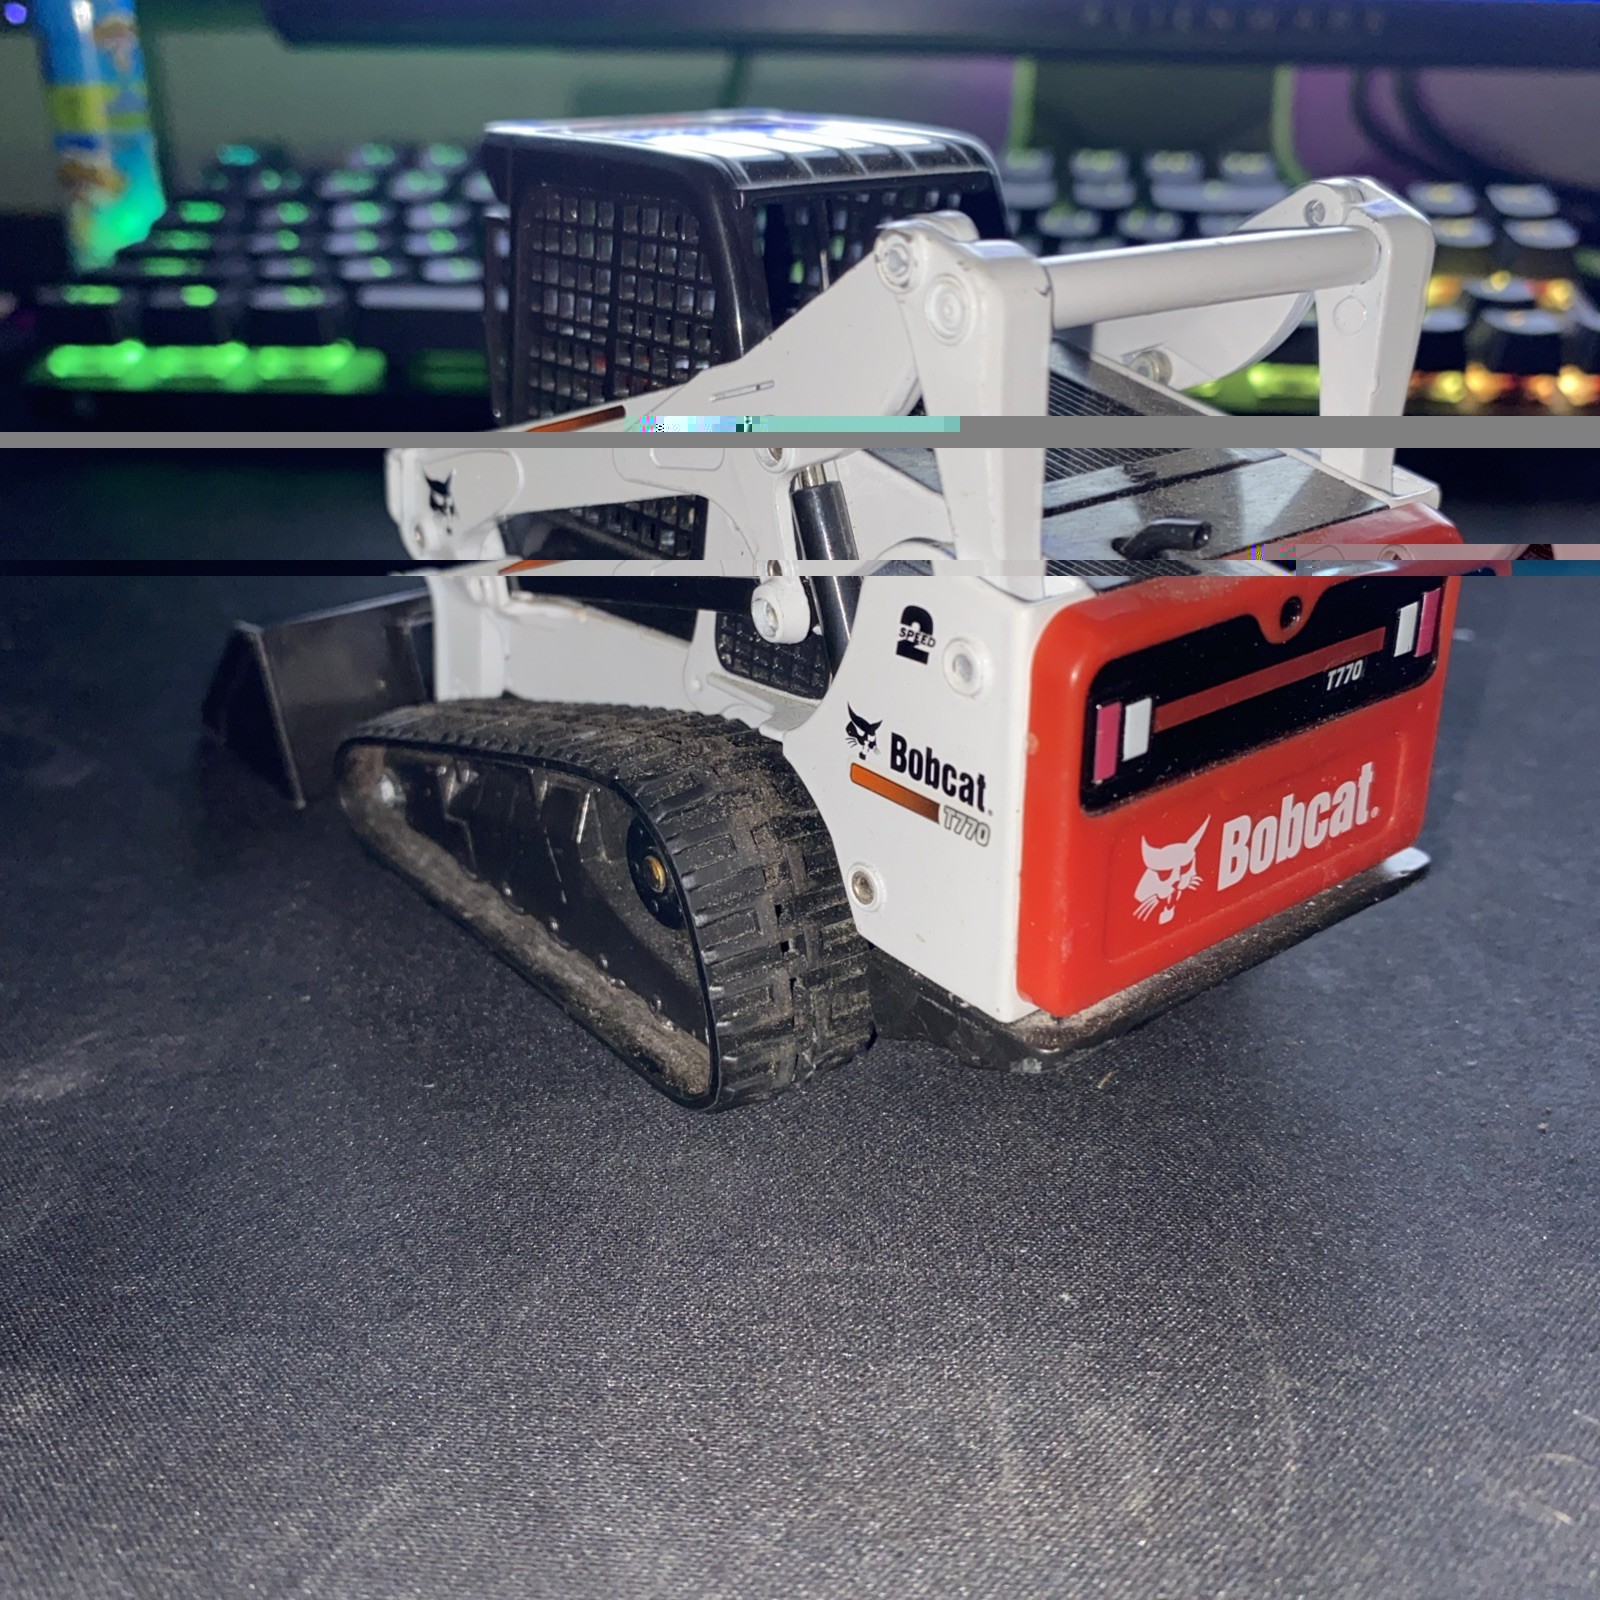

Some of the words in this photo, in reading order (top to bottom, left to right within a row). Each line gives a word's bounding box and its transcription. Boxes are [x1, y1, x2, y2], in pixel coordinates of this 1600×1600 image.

[895, 605, 933, 665] 2
[898, 627, 936, 648] SPEED
[1326, 659, 1363, 691] T770
[943, 806, 991, 847] T770
